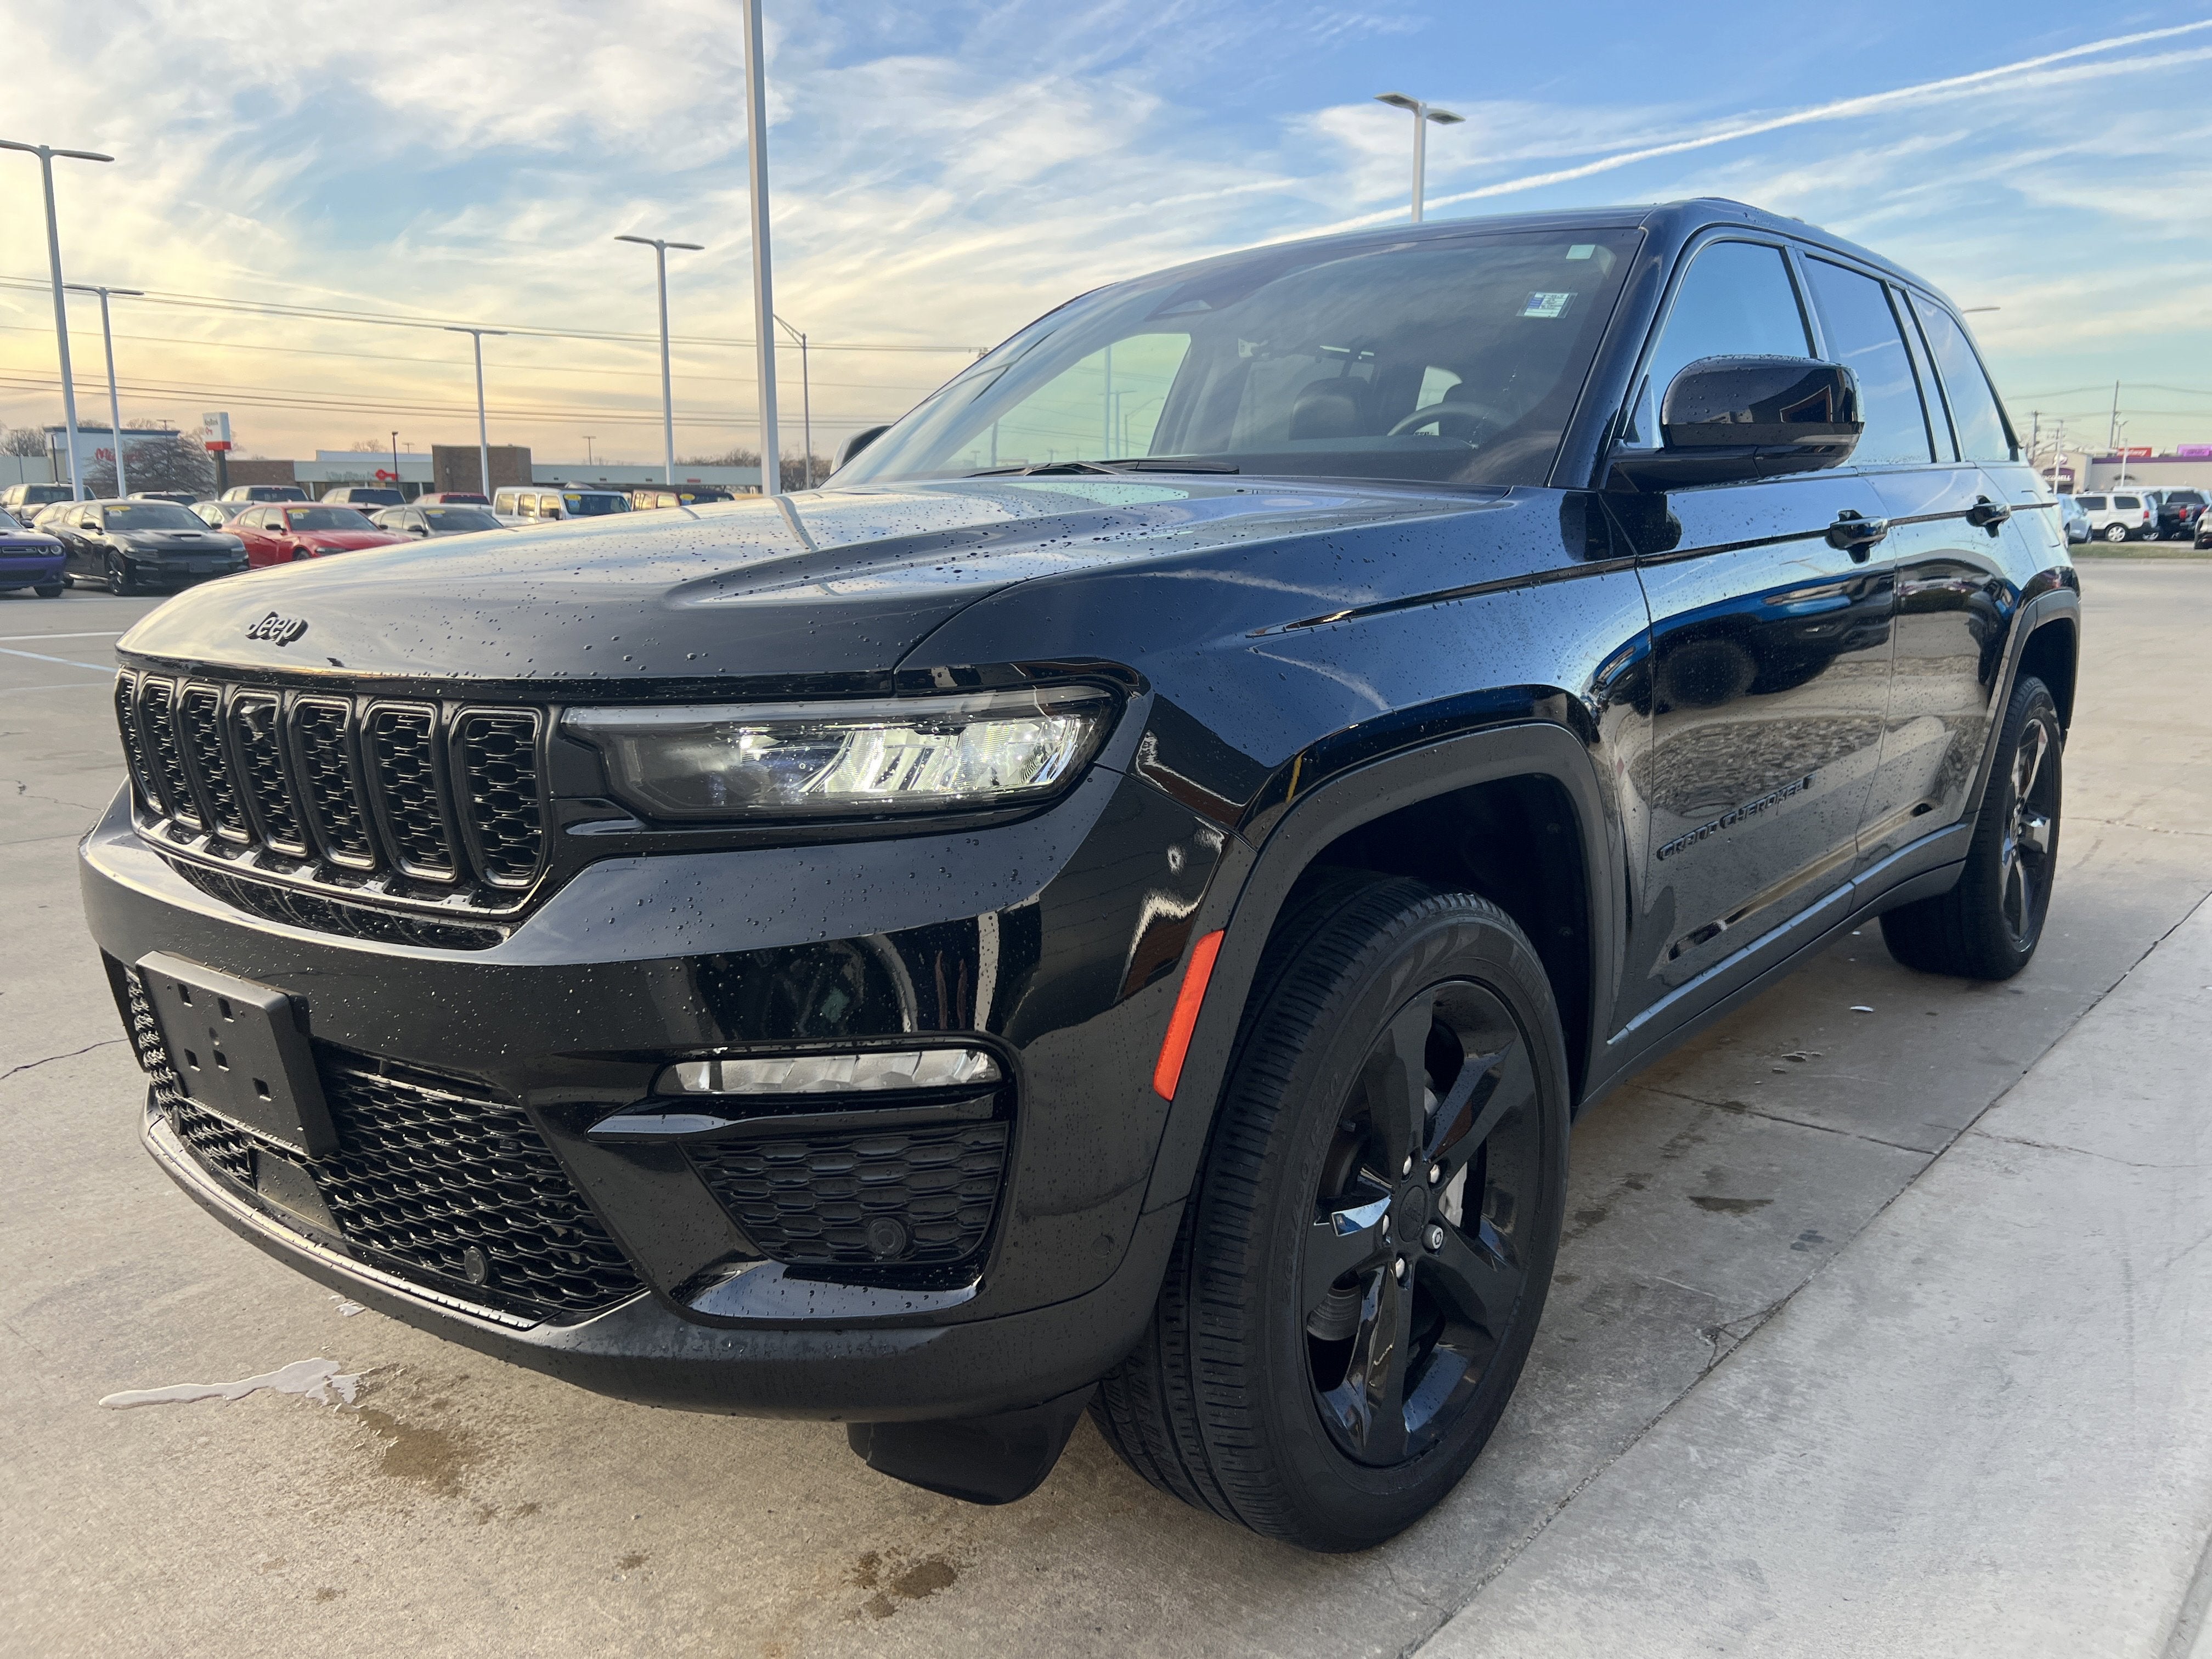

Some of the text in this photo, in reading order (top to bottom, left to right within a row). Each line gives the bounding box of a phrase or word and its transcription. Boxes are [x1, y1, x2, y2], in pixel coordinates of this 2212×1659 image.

[245, 611, 309, 647] Jeep
[1656, 772, 1818, 861] GRAND CHEROKEE
